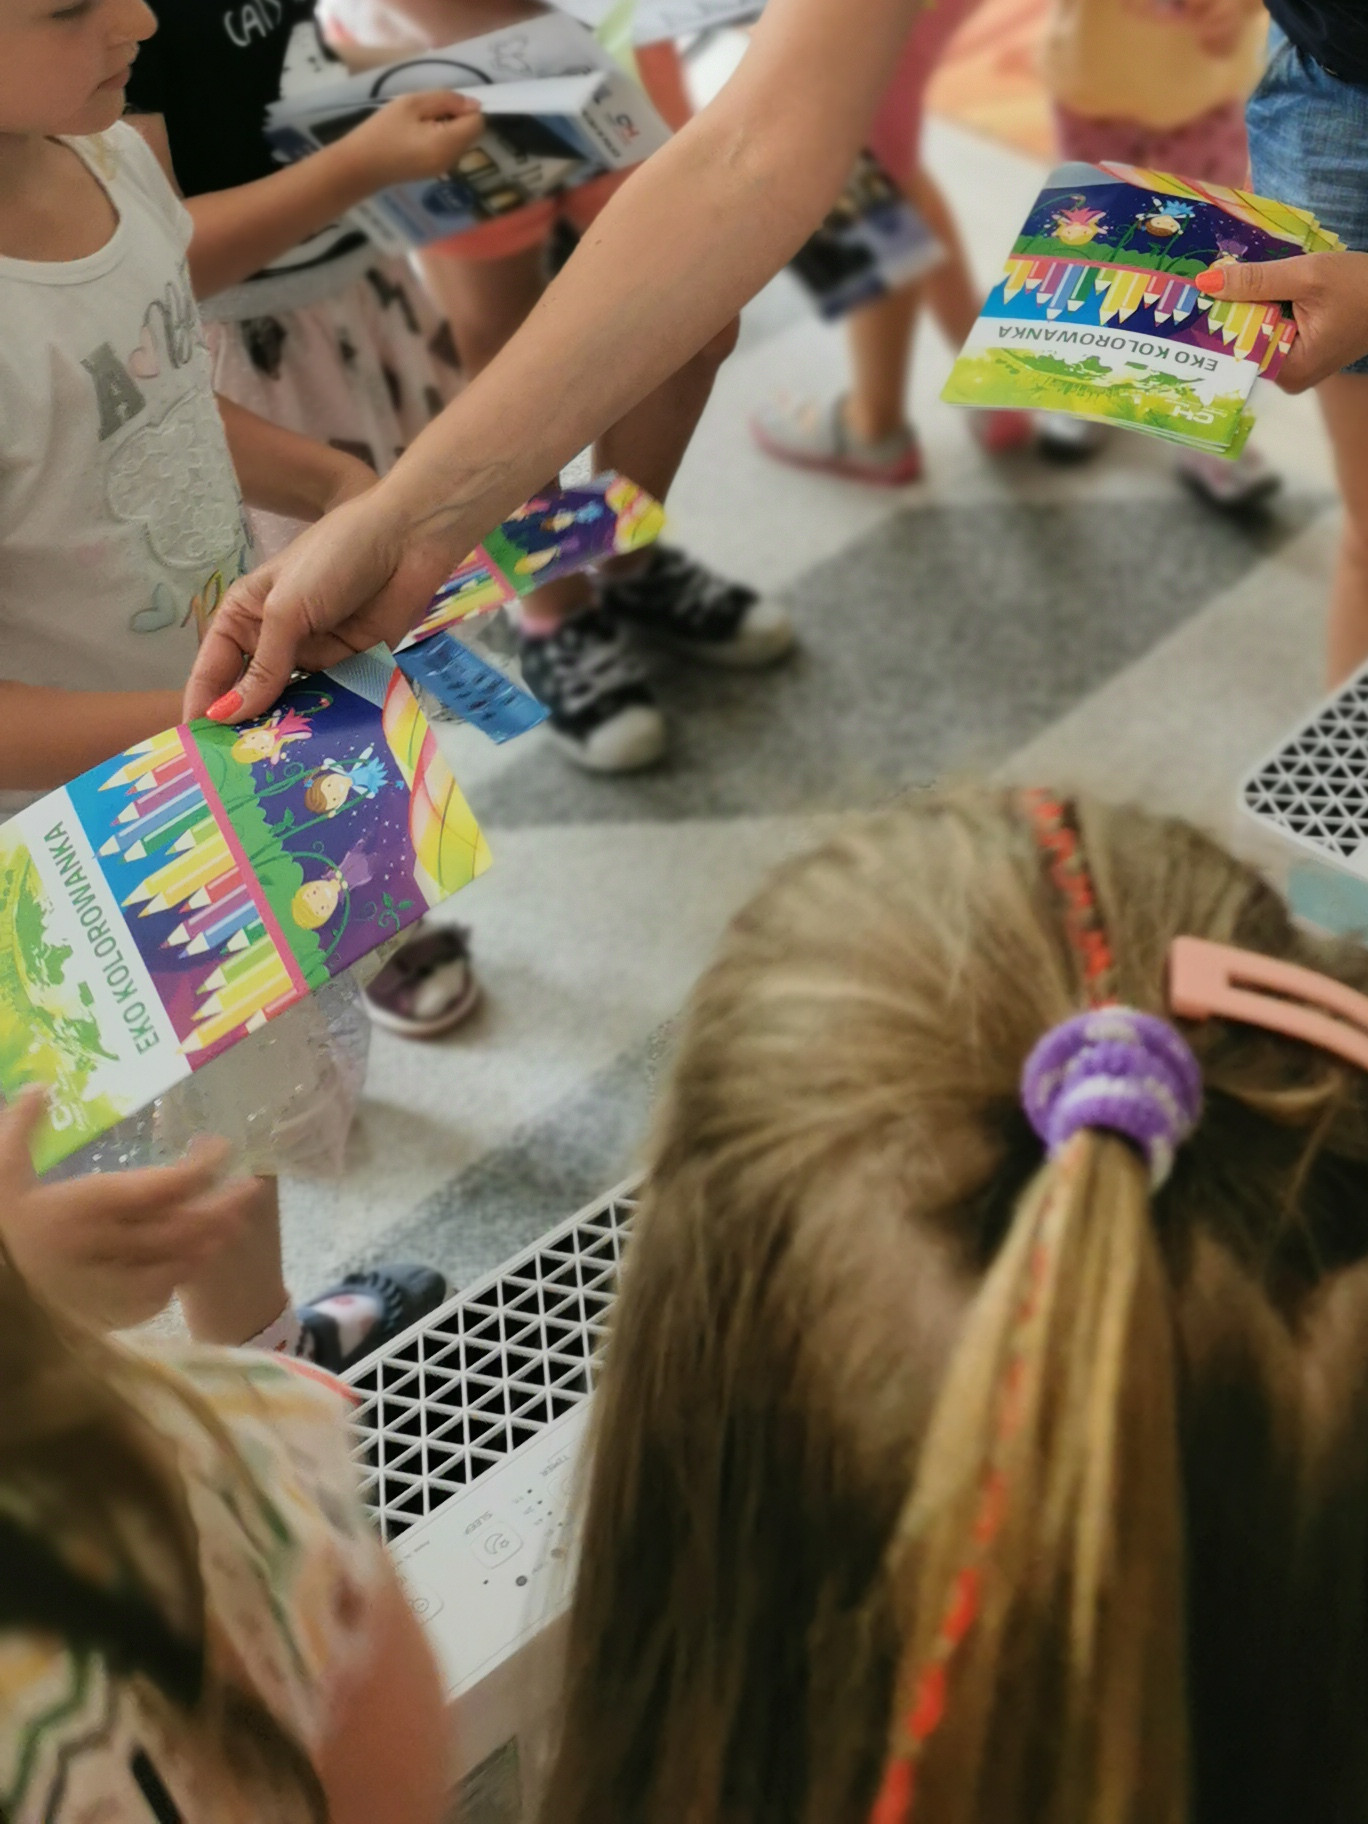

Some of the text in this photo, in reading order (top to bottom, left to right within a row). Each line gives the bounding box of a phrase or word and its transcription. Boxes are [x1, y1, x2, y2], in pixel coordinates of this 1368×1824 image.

[998, 325, 1219, 373] EKO KOLOROWANKA
[43, 820, 139, 1005] KOLOROWANKA
[122, 1000, 160, 1056] EKO
